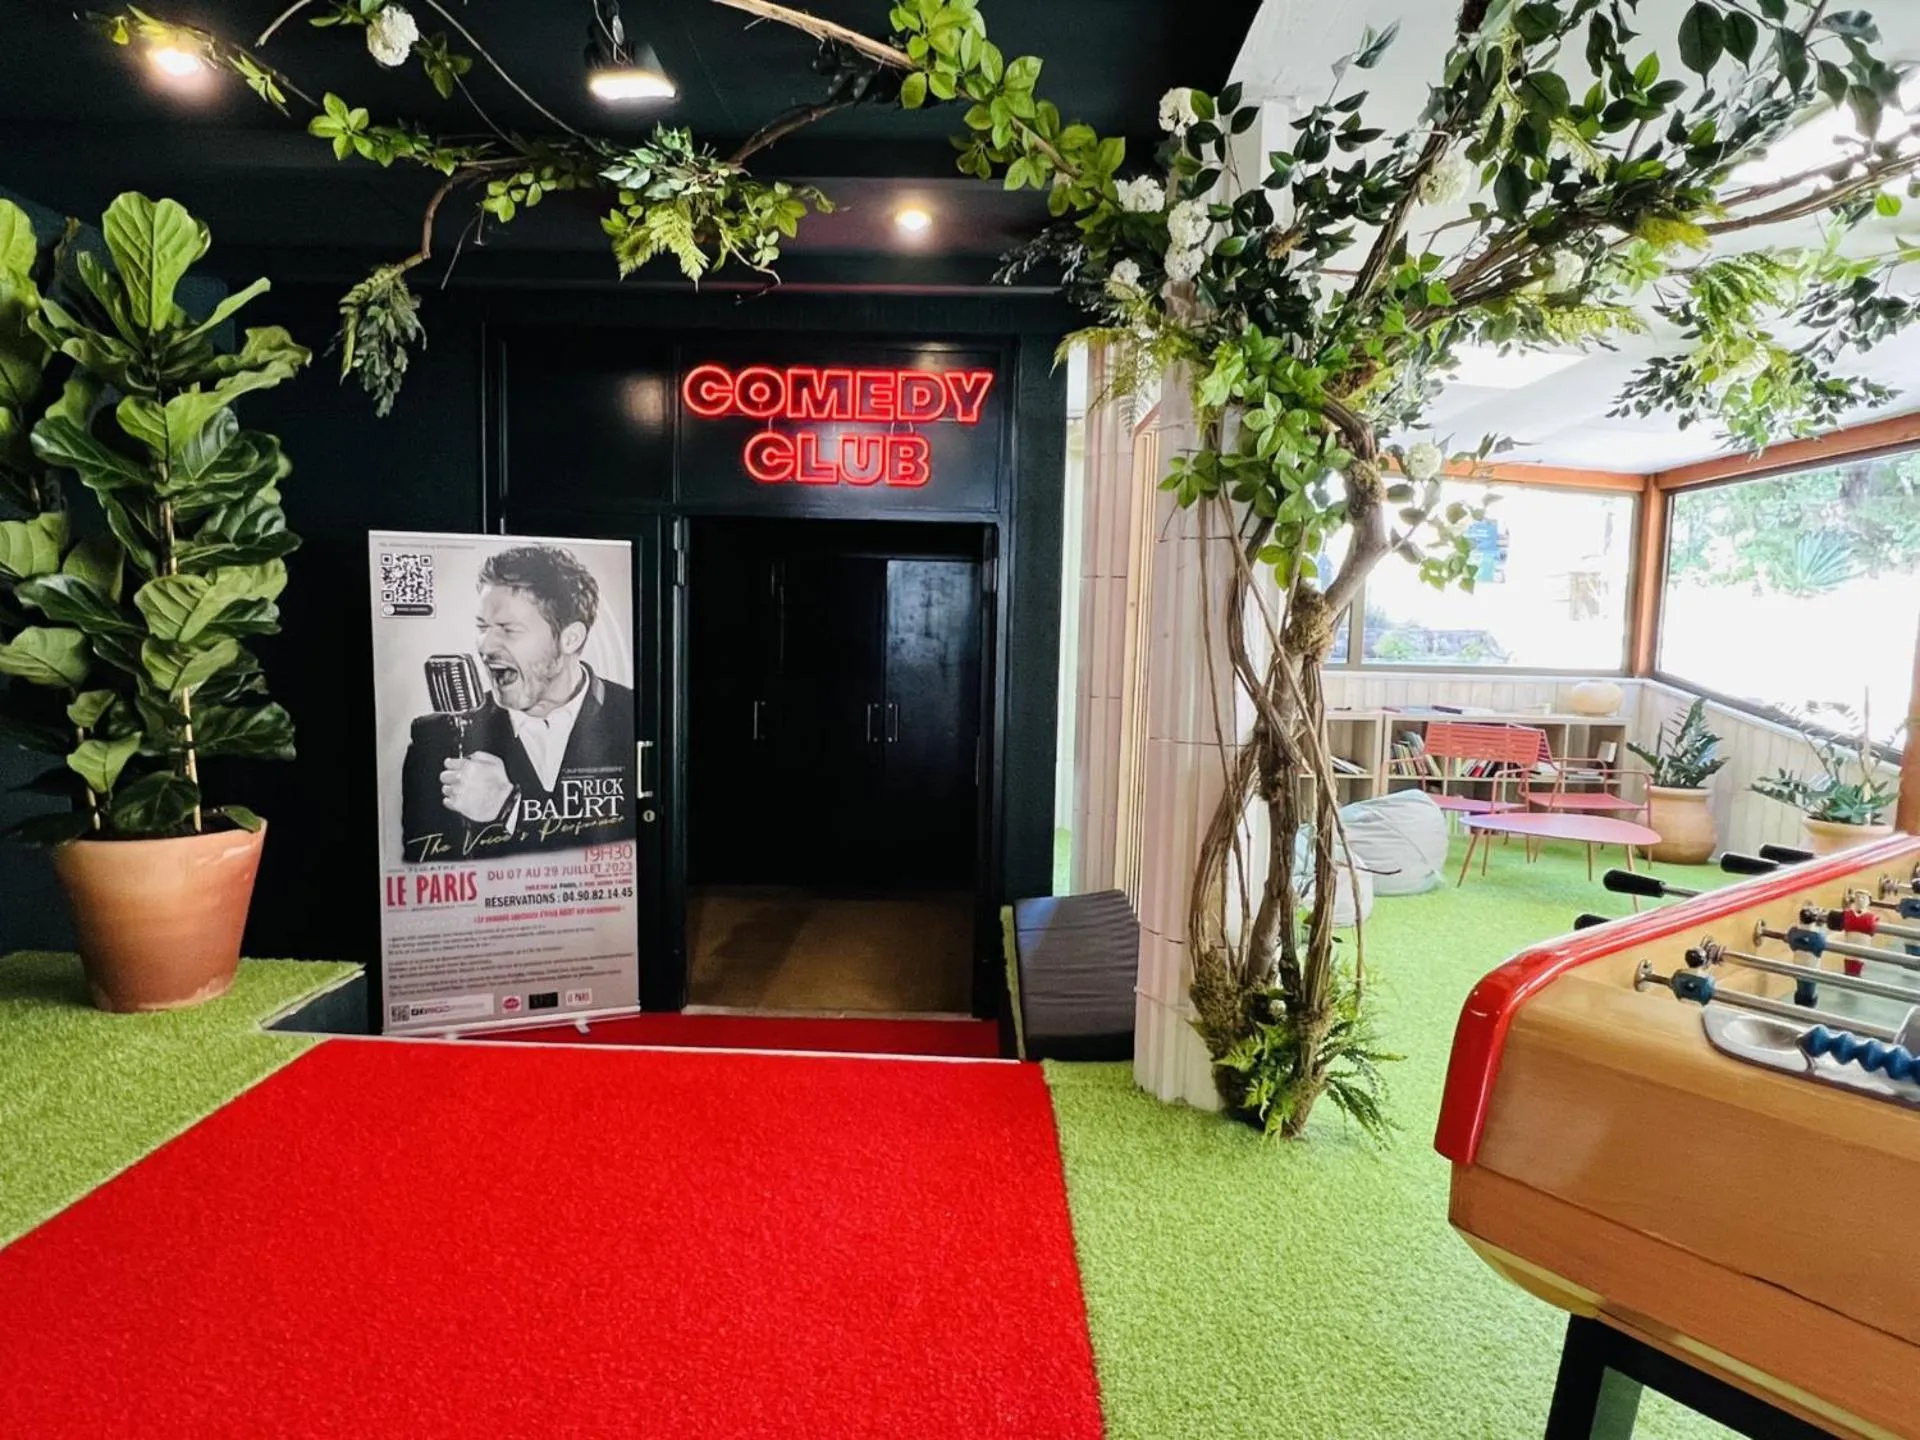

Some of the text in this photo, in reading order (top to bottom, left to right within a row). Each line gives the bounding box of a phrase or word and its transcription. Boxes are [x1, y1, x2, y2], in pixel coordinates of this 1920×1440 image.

[682, 364, 993, 423] COMEDY
[743, 431, 931, 486] CLUB
[522, 780, 625, 821] BAERT
[407, 833, 451, 862] The
[584, 844, 633, 862] 19H30
[386, 871, 478, 907] LE PARIS
[487, 870, 504, 881] DU
[506, 868, 521, 880] 07
[525, 866, 541, 878] AU
[562, 862, 601, 876] JUILLET
[605, 861, 633, 873] 2023
